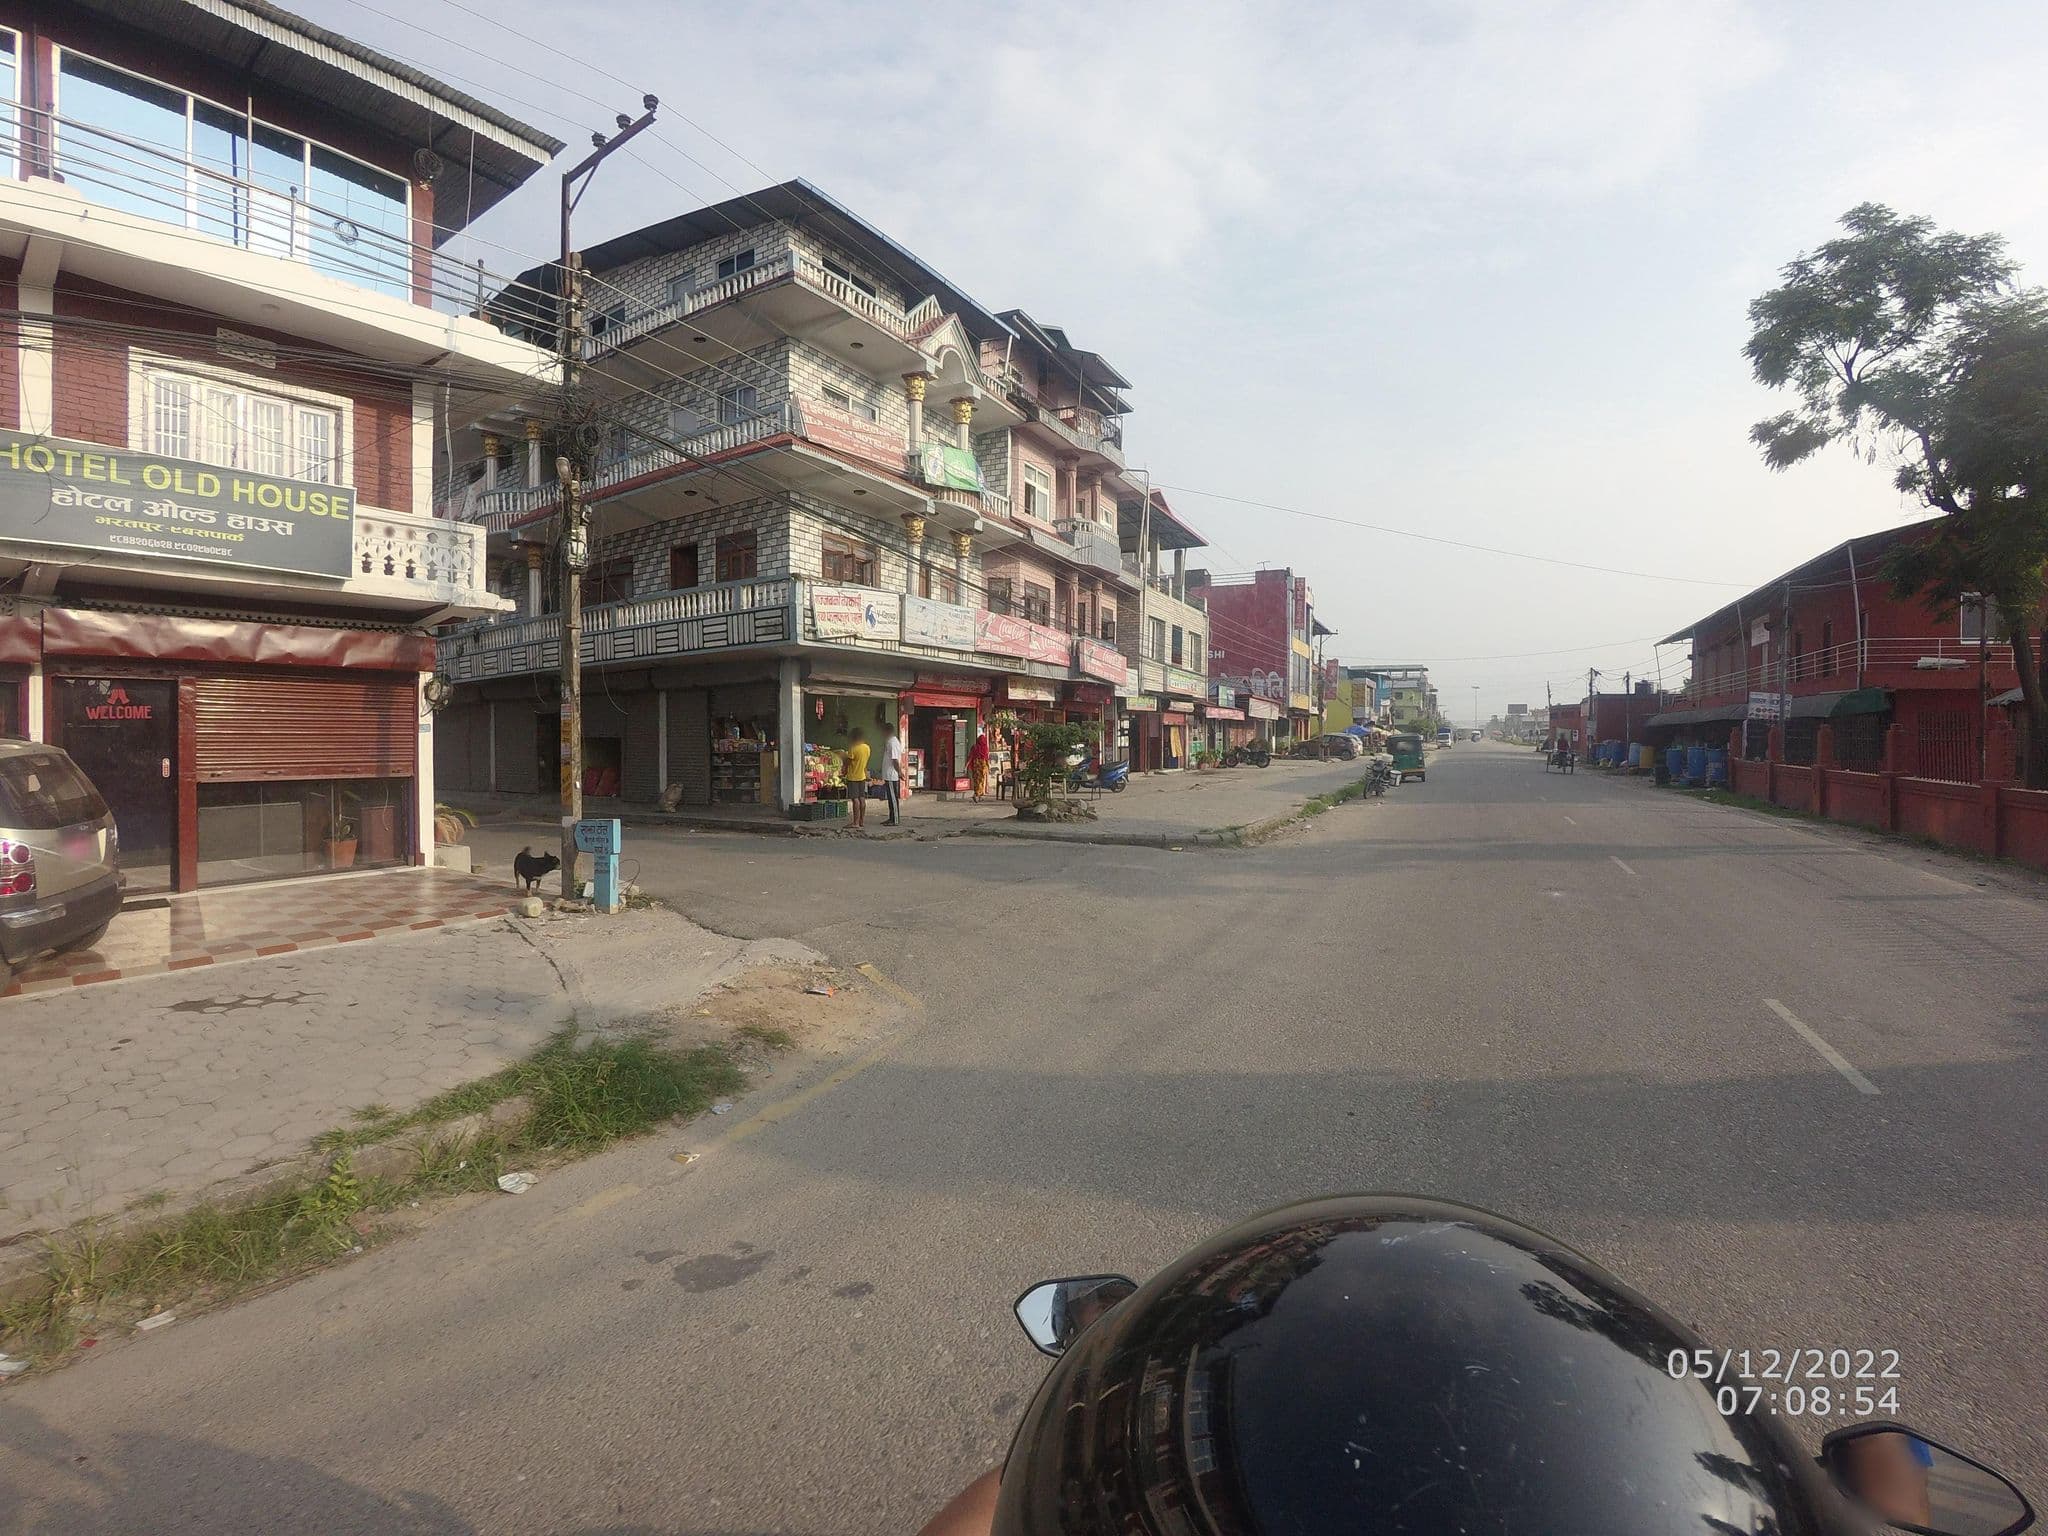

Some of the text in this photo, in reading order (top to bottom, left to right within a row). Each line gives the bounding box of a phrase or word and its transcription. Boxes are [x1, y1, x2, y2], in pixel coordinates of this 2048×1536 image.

[0, 442, 350, 521] HOTEL OLD HOUSE
[51, 485, 295, 536] होटल ओल्ड हाउस
[85, 705, 152, 720] WELCOME
